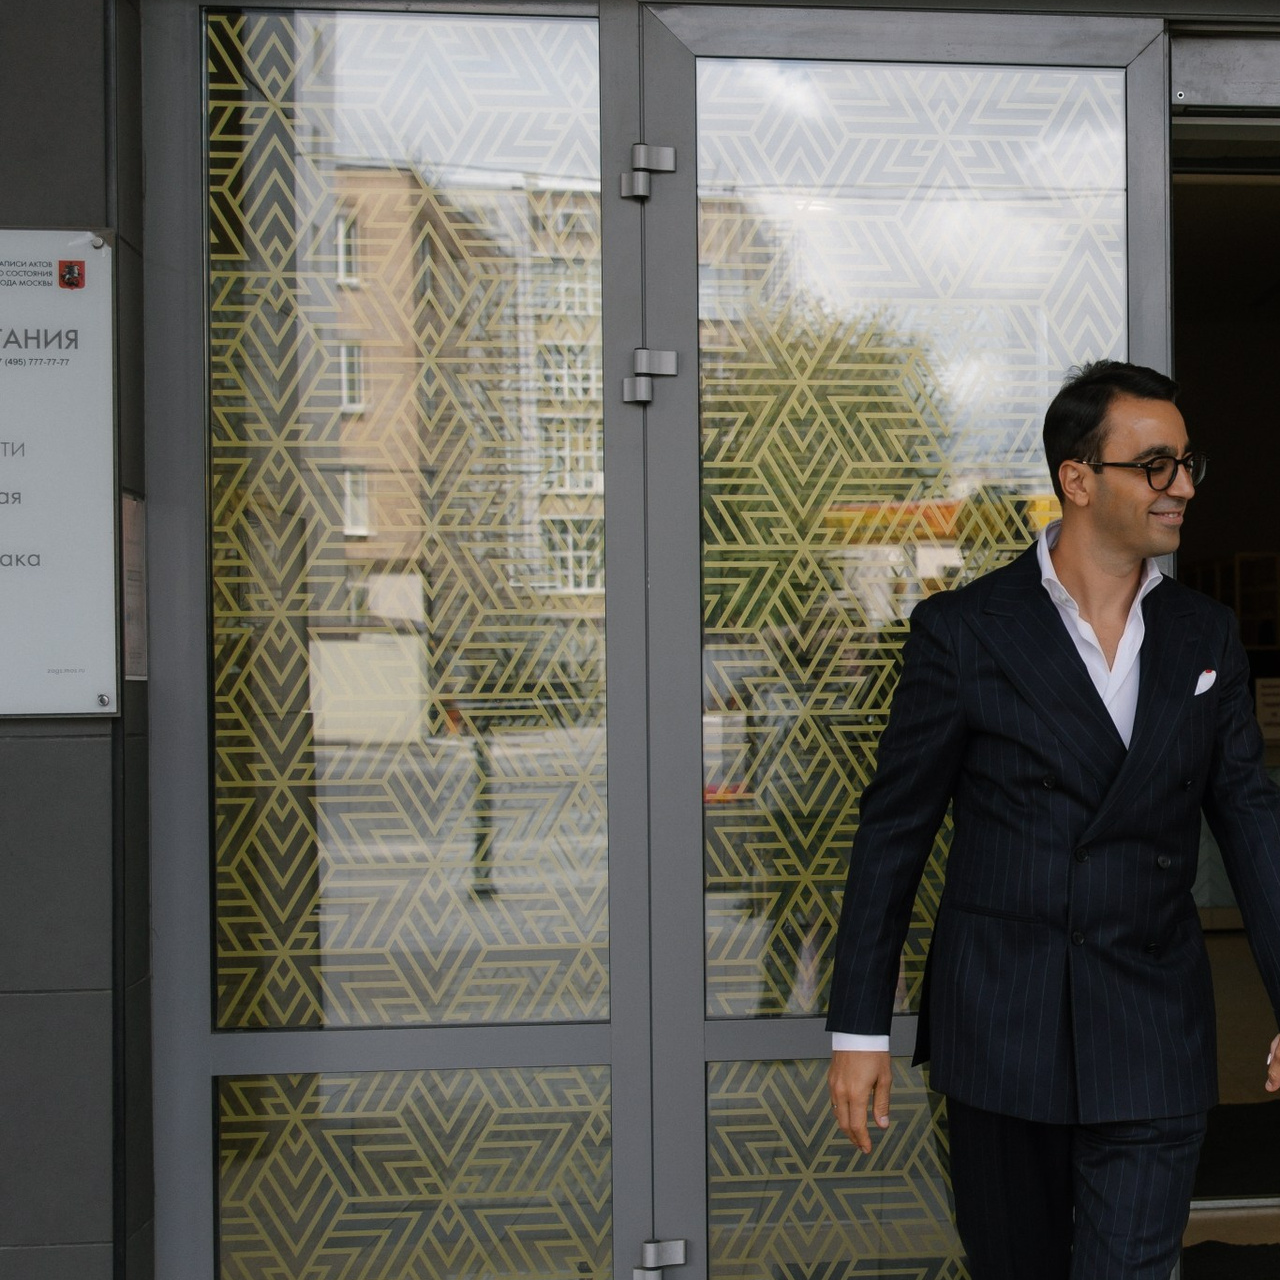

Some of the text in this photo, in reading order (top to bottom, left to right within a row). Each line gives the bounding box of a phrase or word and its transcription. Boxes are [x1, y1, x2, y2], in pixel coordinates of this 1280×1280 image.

[19, 279, 53, 287] МОСКВЫ
[4, 358, 26, 367] (495)
[28, 358, 70, 366] 777-77-77
